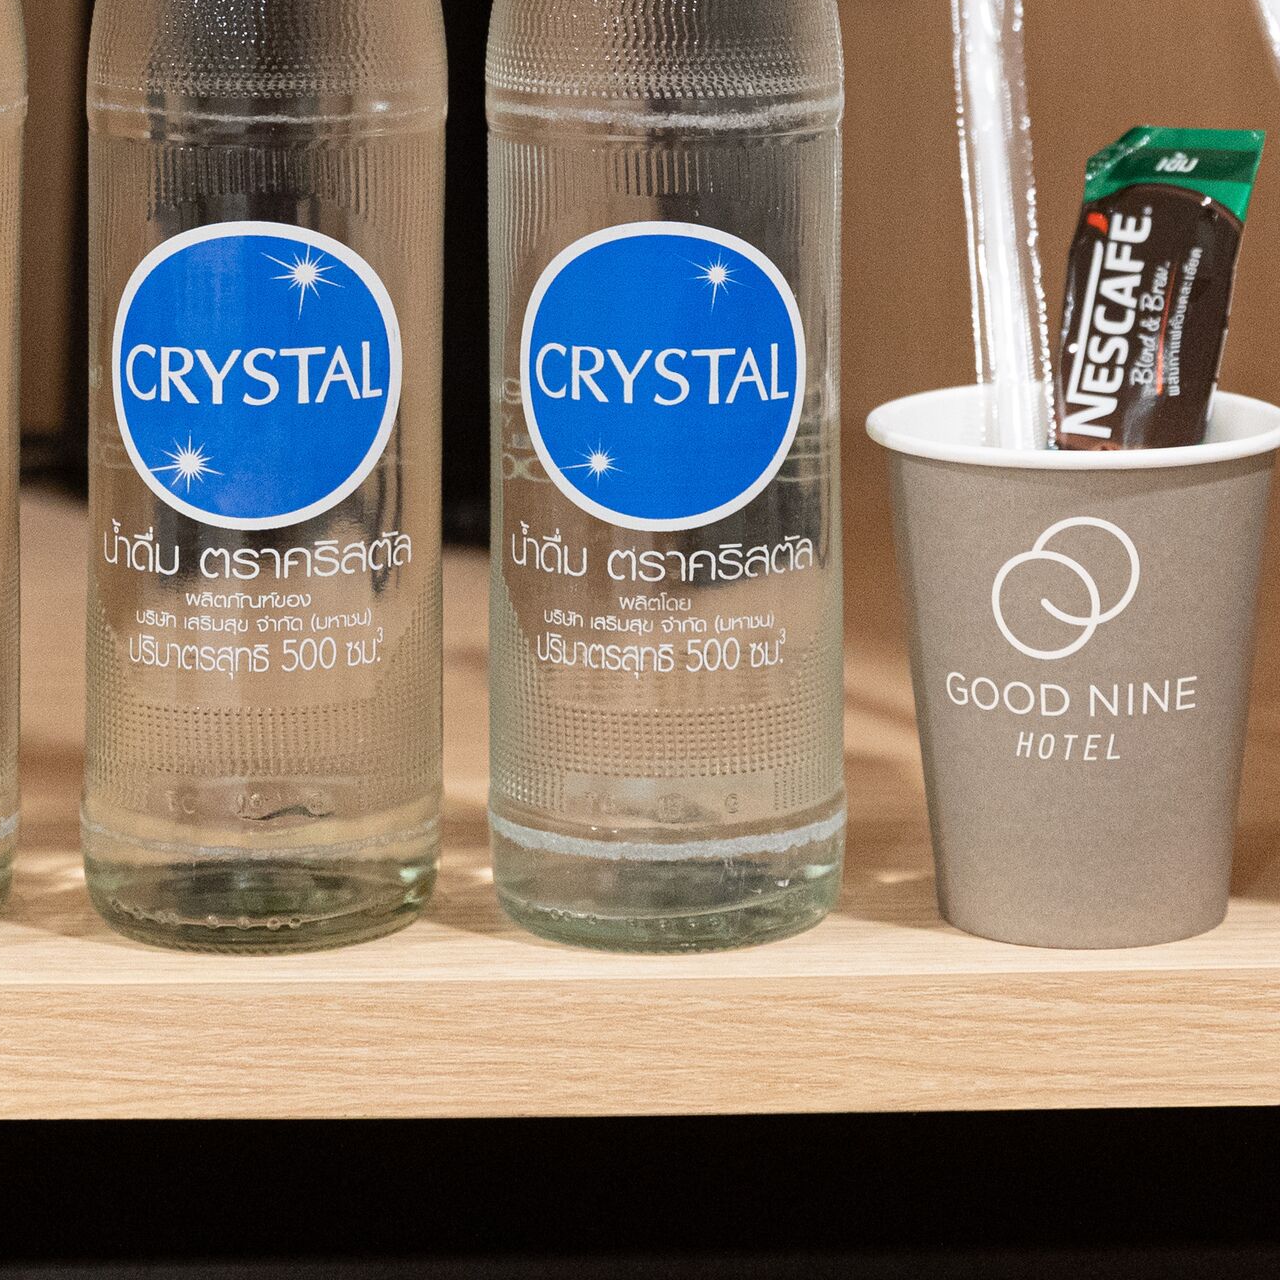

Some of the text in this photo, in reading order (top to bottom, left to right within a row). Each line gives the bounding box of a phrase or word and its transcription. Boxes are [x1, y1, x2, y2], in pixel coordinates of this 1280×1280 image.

[126, 341, 383, 406] CRYSTAL
[535, 342, 789, 406] CRYSTAL
[1129, 332, 1158, 387] Blend
[104, 519, 412, 580] น้ำดื่ม ตราคริสตัล
[512, 521, 813, 582] น้ำดื่ม ตราคริสตัล
[136, 608, 372, 635] บริษัท เสริมสุข จำกัด (มหาชน)
[186, 590, 311, 609] ผลิตภัณฑ์ของ
[544, 609, 774, 635] บริษัท เสริมสุข จำกัด (มหาชน)
[619, 592, 692, 612] ผลิตโดย
[129, 634, 269, 680] ปริมาตรสุทธิ
[282, 637, 336, 672] 500
[537, 632, 674, 680] ปริมาตรสุทธิ
[686, 637, 741, 673] 500
[946, 671, 1198, 717] GOOD NINE
[1016, 731, 1121, 761] HOTEL
